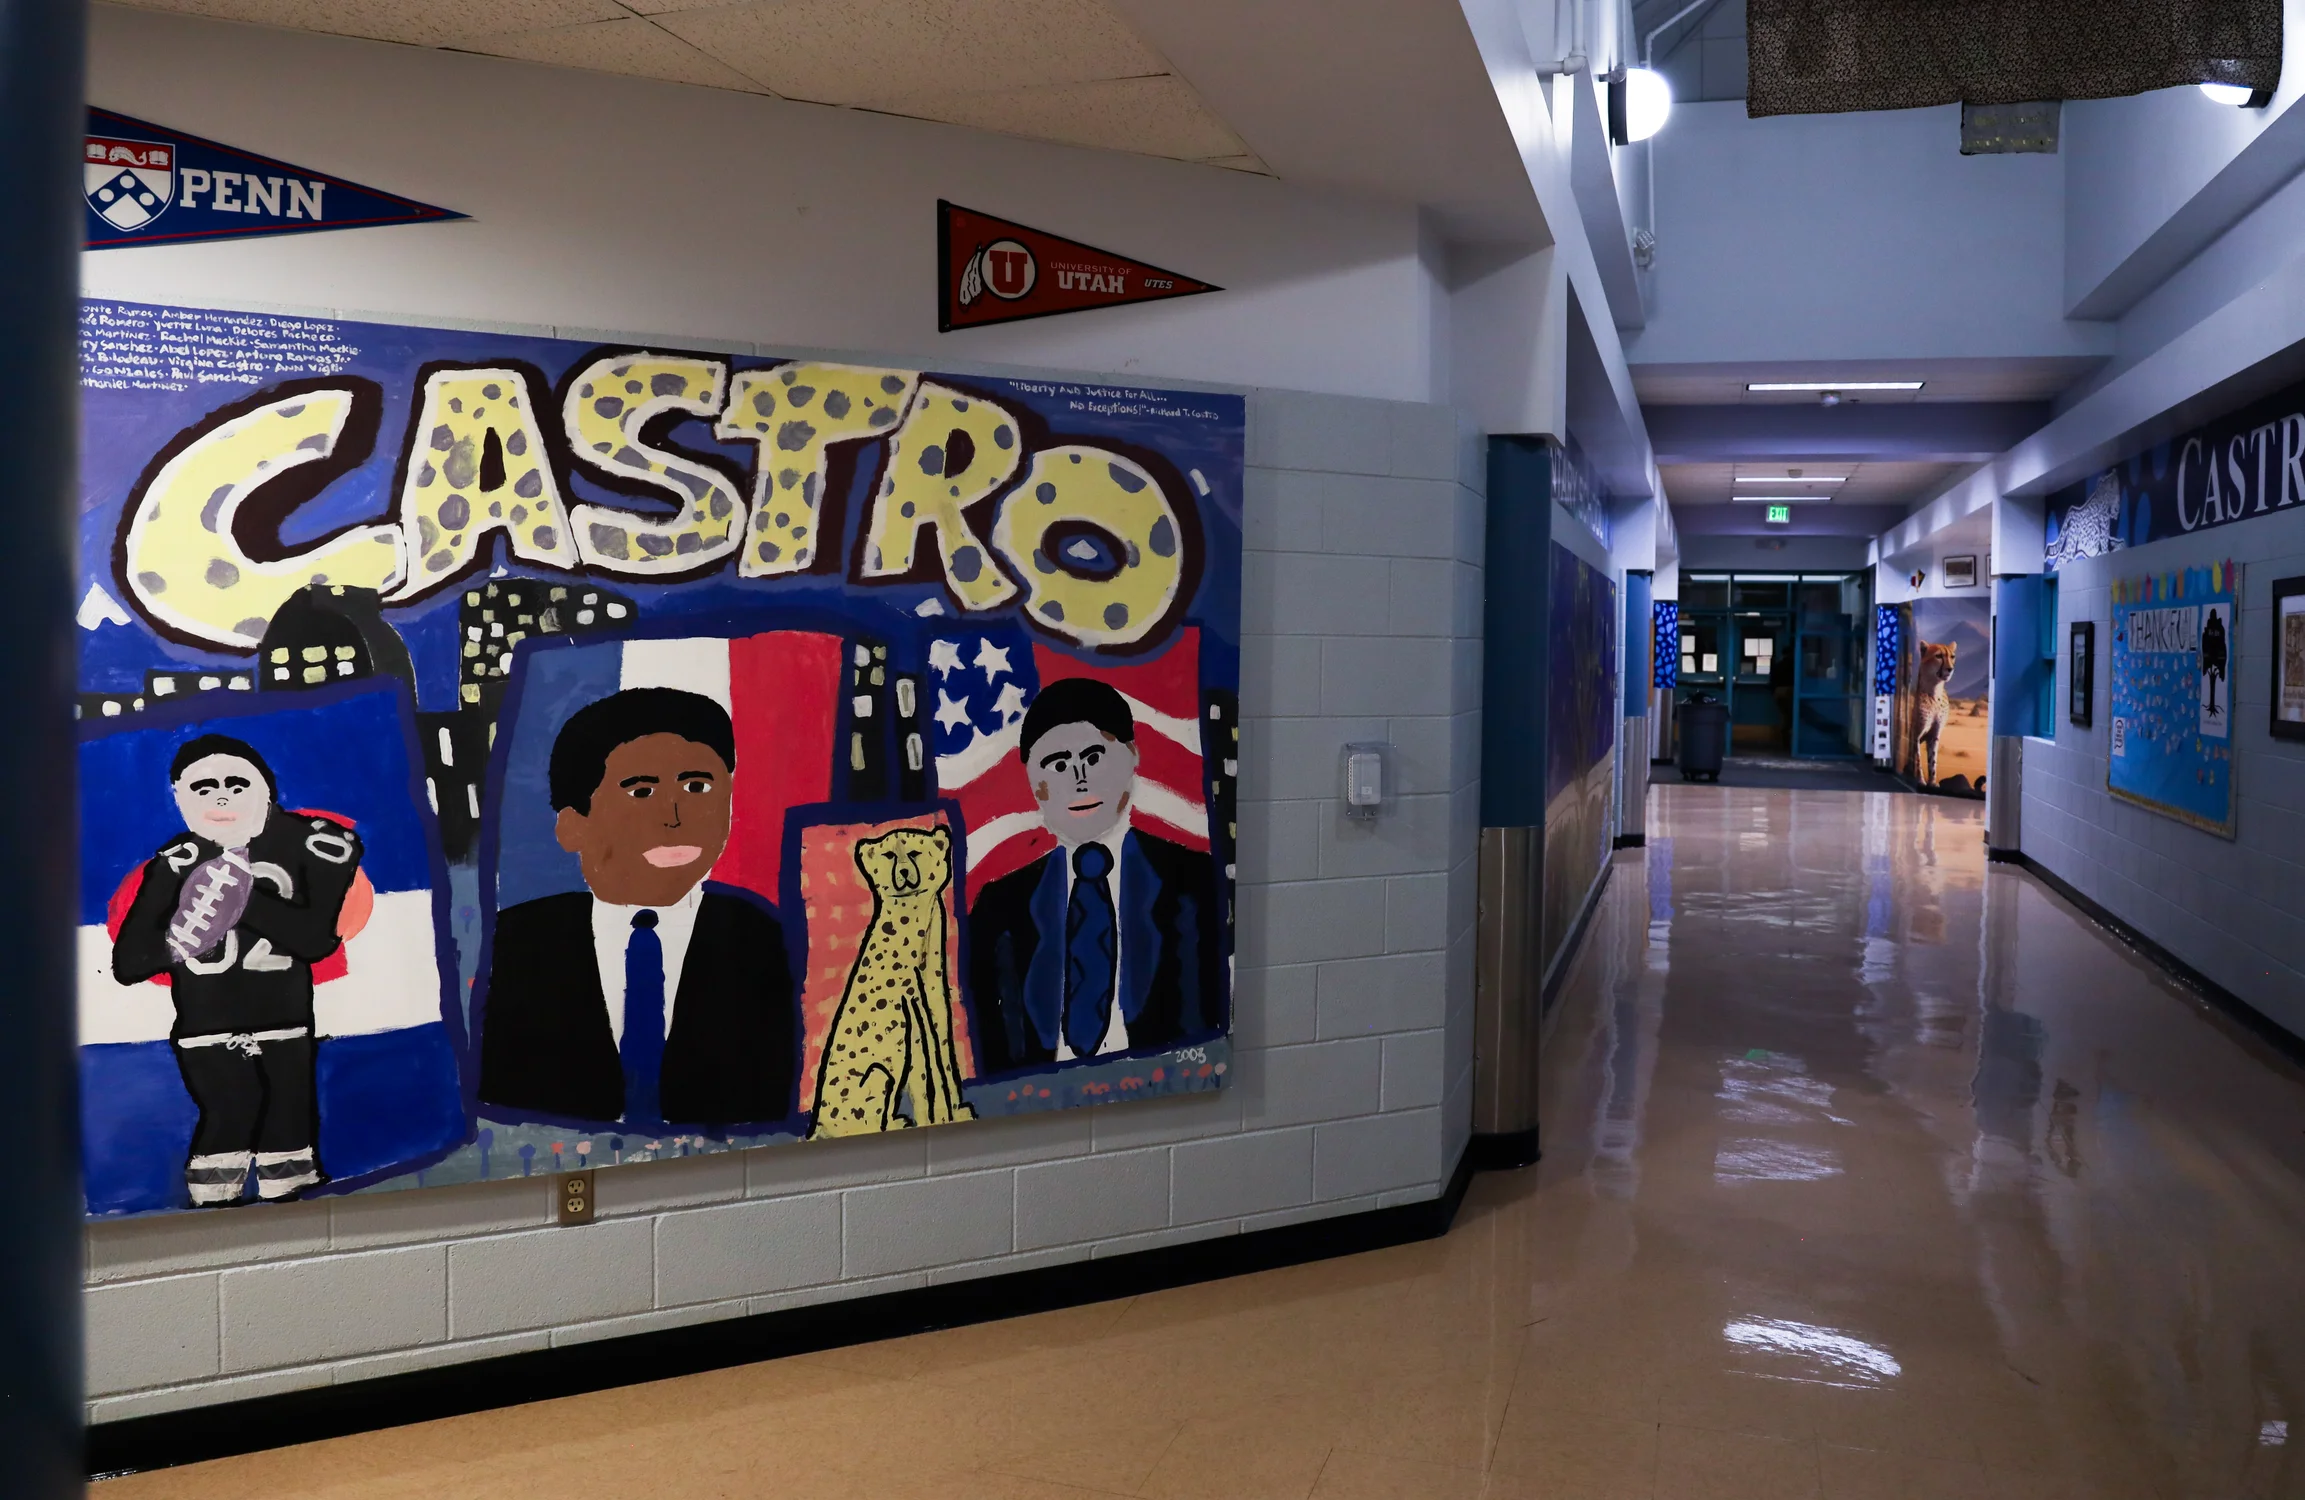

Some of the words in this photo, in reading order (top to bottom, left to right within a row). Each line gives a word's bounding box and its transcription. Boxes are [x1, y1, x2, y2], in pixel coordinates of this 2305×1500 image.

[180, 167, 326, 221] PENN
[1050, 261, 1115, 274] UNIVERSITY
[1117, 267, 1132, 275] OF
[1057, 270, 1125, 294] UTAH
[1144, 278, 1173, 290] UTES
[2177, 412, 2305, 531] CASTR
[124, 350, 1187, 649] CASTRO
[1768, 506, 1789, 521] EXIT
[2129, 607, 2197, 651] THANKFUL
